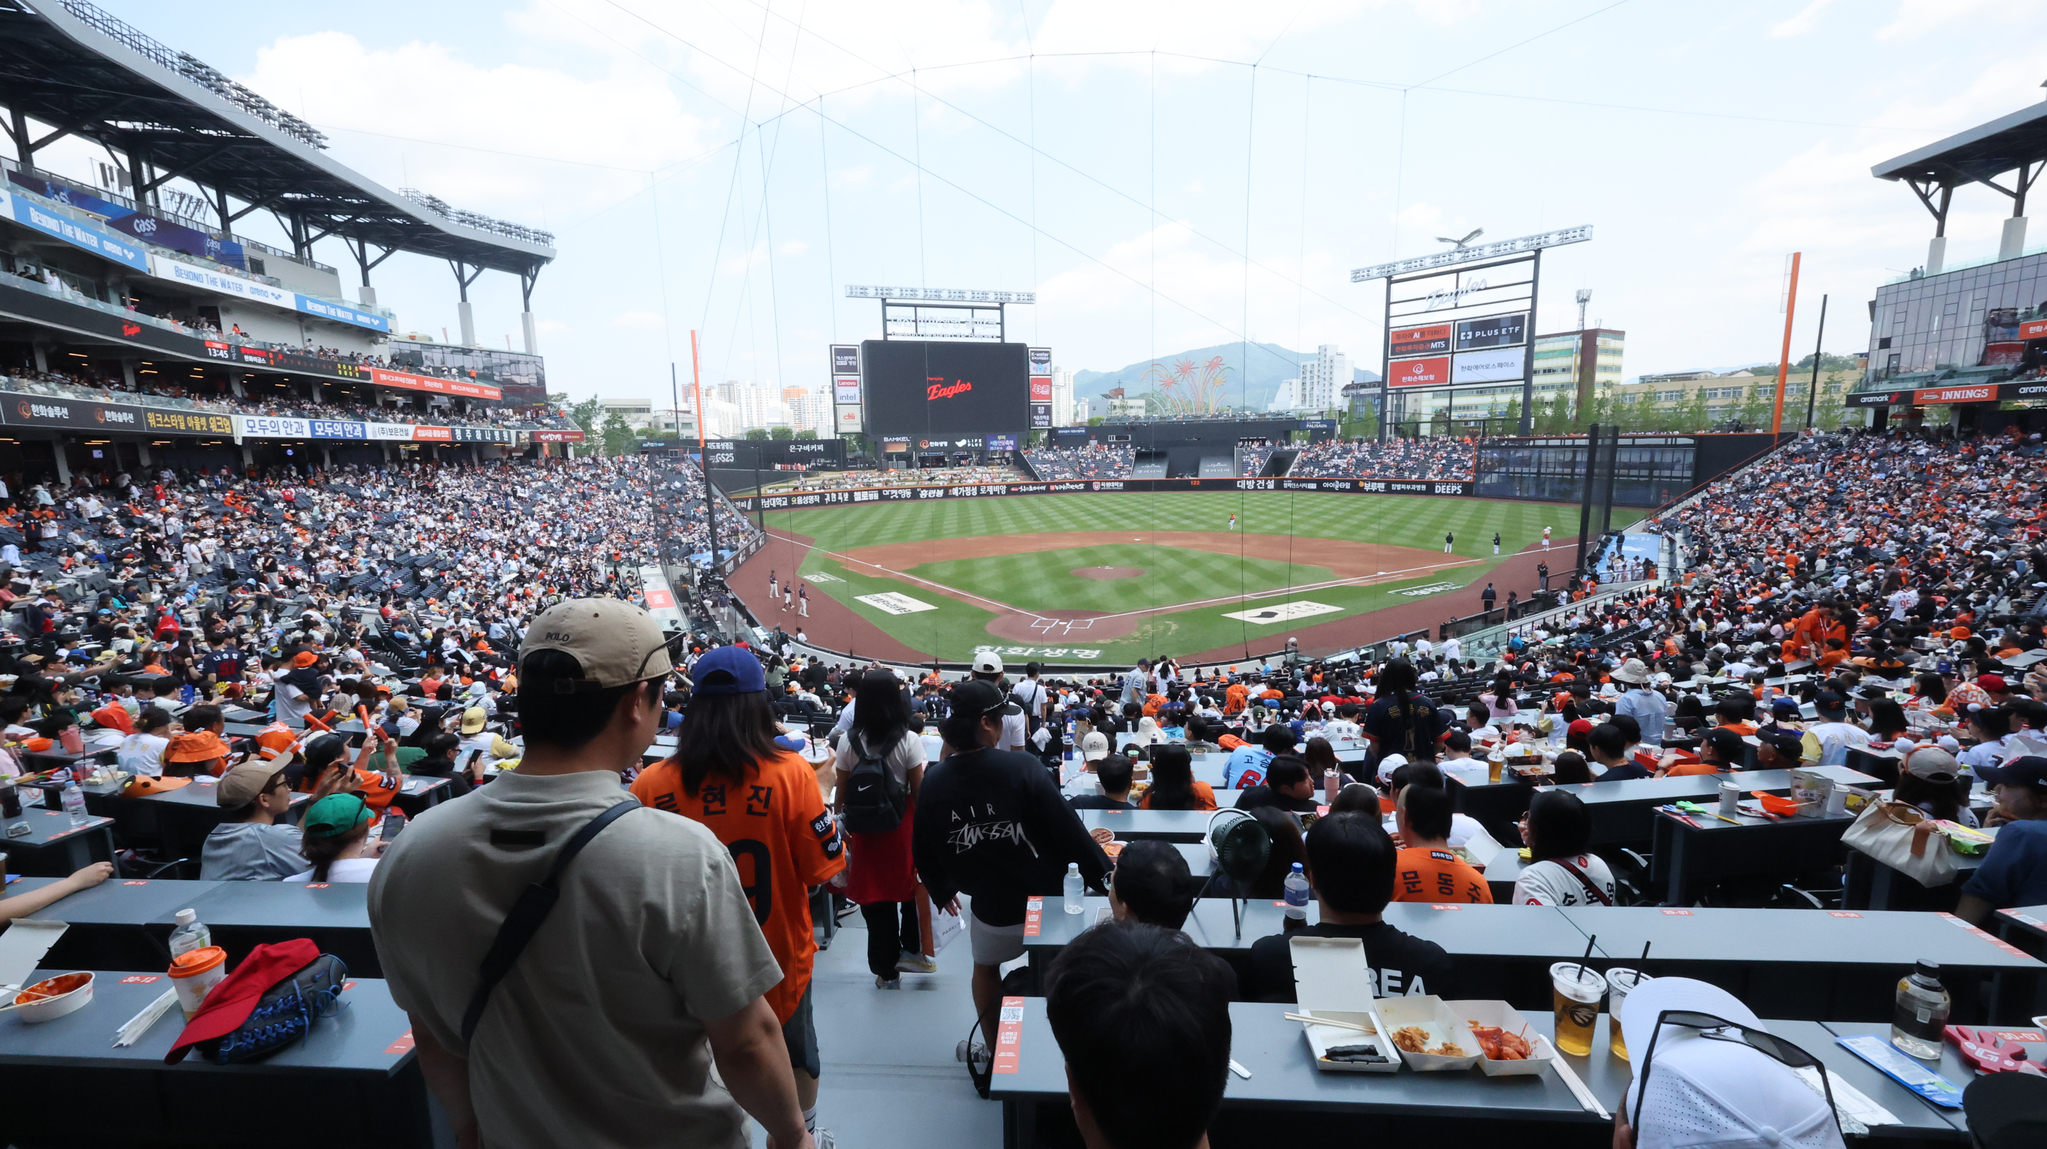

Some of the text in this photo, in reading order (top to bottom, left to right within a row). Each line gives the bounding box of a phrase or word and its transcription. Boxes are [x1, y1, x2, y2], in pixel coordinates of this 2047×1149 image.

[1425, 277, 1488, 311] Eagles
[1475, 325, 1521, 338] PLUS ETF
[207, 347, 229, 359] 13:45
[1460, 362, 1516, 372] 한화에어로스페이스
[1402, 374, 1435, 383] 한화손해보험
[927, 380, 972, 401] Eagles
[1941, 389, 1989, 400] INNINGS
[1860, 394, 1889, 403] aramark
[31, 404, 70, 418] 한화솔루션
[104, 410, 135, 423] 한화솔루션
[147, 412, 186, 430] 워크스타일
[186, 415, 208, 431] 아울렛
[246, 419, 304, 436] 모두의 안과
[315, 422, 363, 438] 모두의 안과
[715, 453, 734, 463] GS25
[1236, 479, 1275, 490] 대방건설
[1434, 485, 1463, 495] DEEPS
[1899, 599, 1911, 609] 95
[545, 632, 570, 642] POLO
[974, 645, 1101, 659] 한화생명
[951, 803, 996, 823] AIR
[1401, 870, 1481, 904] 문동주
[1998, 1032, 2042, 1041] 30-07
